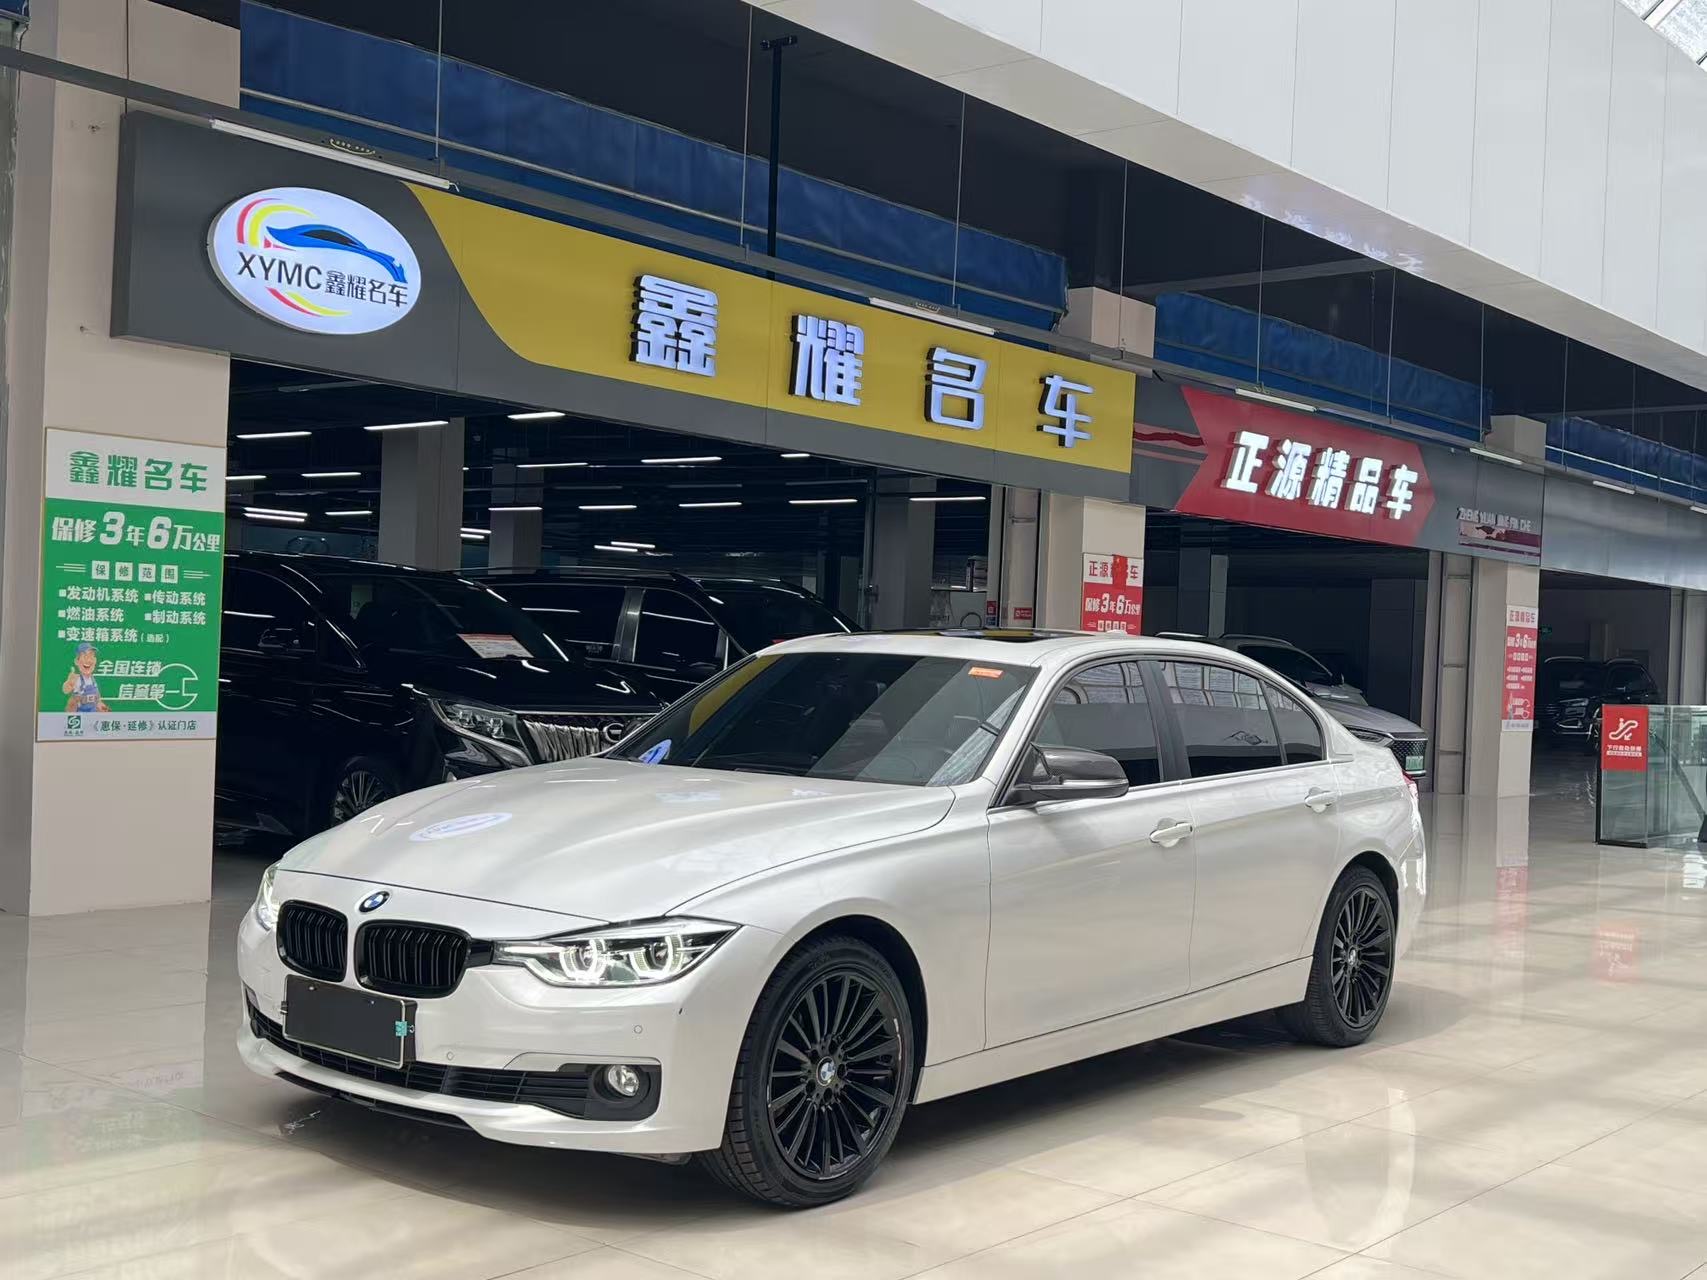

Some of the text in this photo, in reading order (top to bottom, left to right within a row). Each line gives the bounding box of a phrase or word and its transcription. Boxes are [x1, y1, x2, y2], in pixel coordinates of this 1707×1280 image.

[236, 250, 409, 307] XYMC 鑫耀名车
[631, 273, 1095, 449] 鑫耀名车
[68, 450, 209, 494] 鑫耀名车
[1220, 430, 1419, 521] 正源精品车
[51, 511, 221, 553] 保修3年6万公里
[94, 562, 176, 581] 保修范围
[1088, 560, 1139, 580] 正源车
[67, 585, 139, 604] 发动机系统
[152, 589, 207, 606] 传动系统
[66, 605, 125, 623] 燃油系统
[152, 609, 207, 625] 制动系统
[65, 626, 138, 643] 变速箱系统
